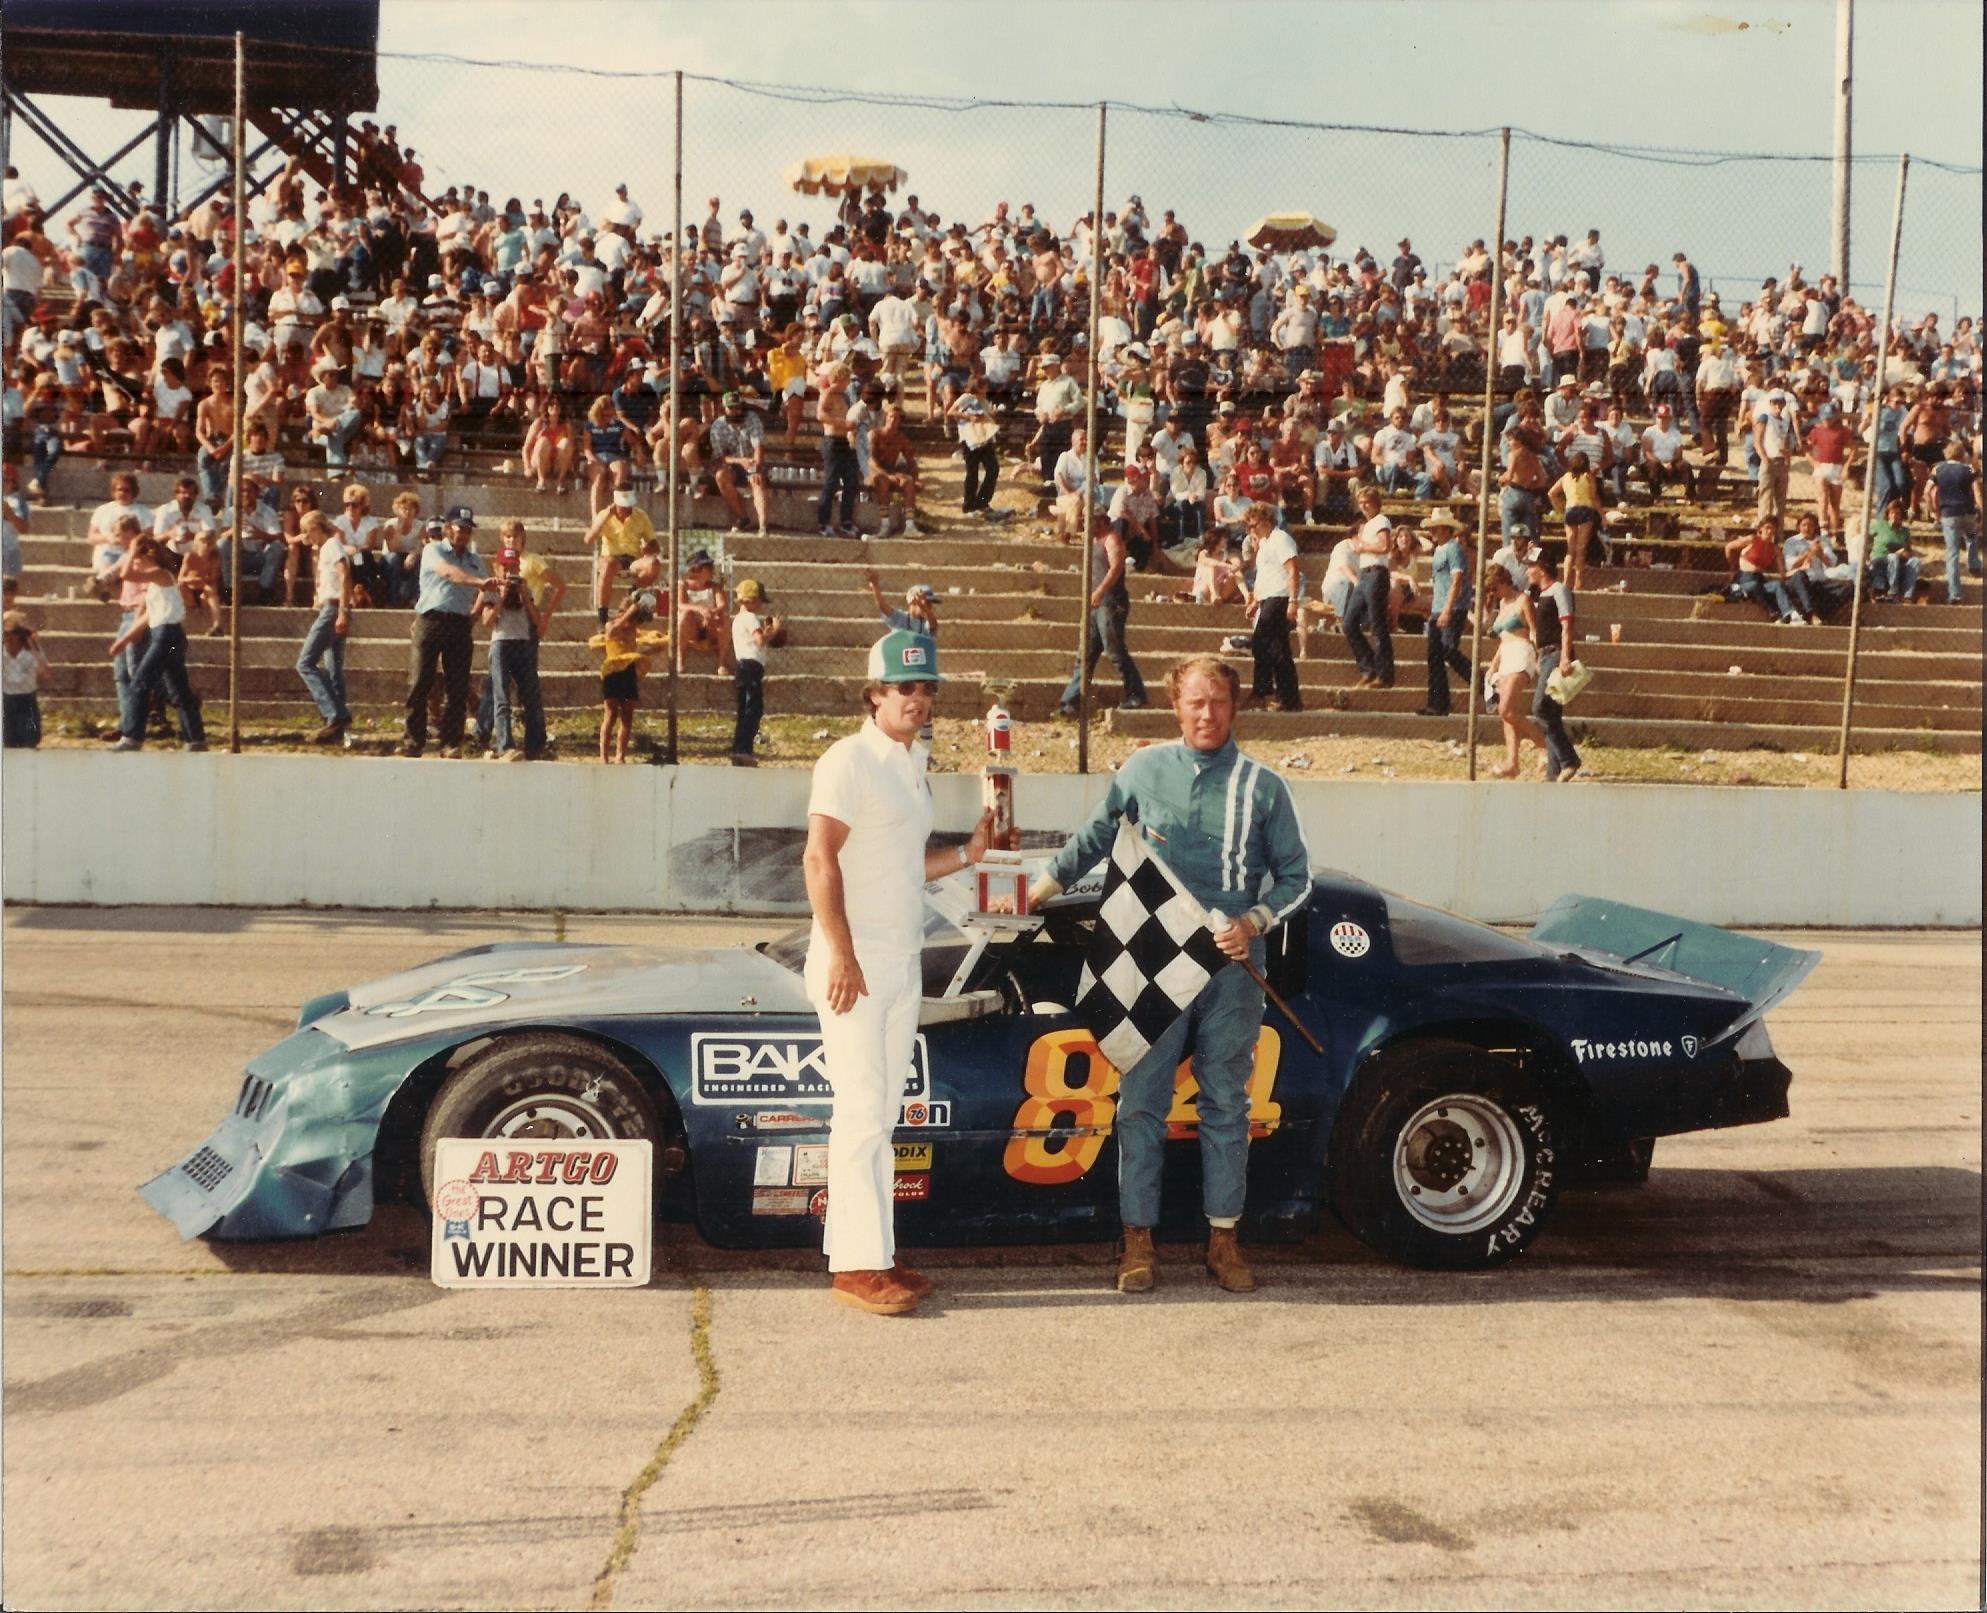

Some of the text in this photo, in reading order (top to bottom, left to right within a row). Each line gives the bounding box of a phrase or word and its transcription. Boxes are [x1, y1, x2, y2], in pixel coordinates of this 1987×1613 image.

[1571, 1039, 1672, 1064] Firestone
[704, 1083, 786, 1092] ENGINEERED
[469, 1151, 618, 1185] ARTGO
[478, 1196, 605, 1232] RACE
[451, 1242, 634, 1277] WINNER
